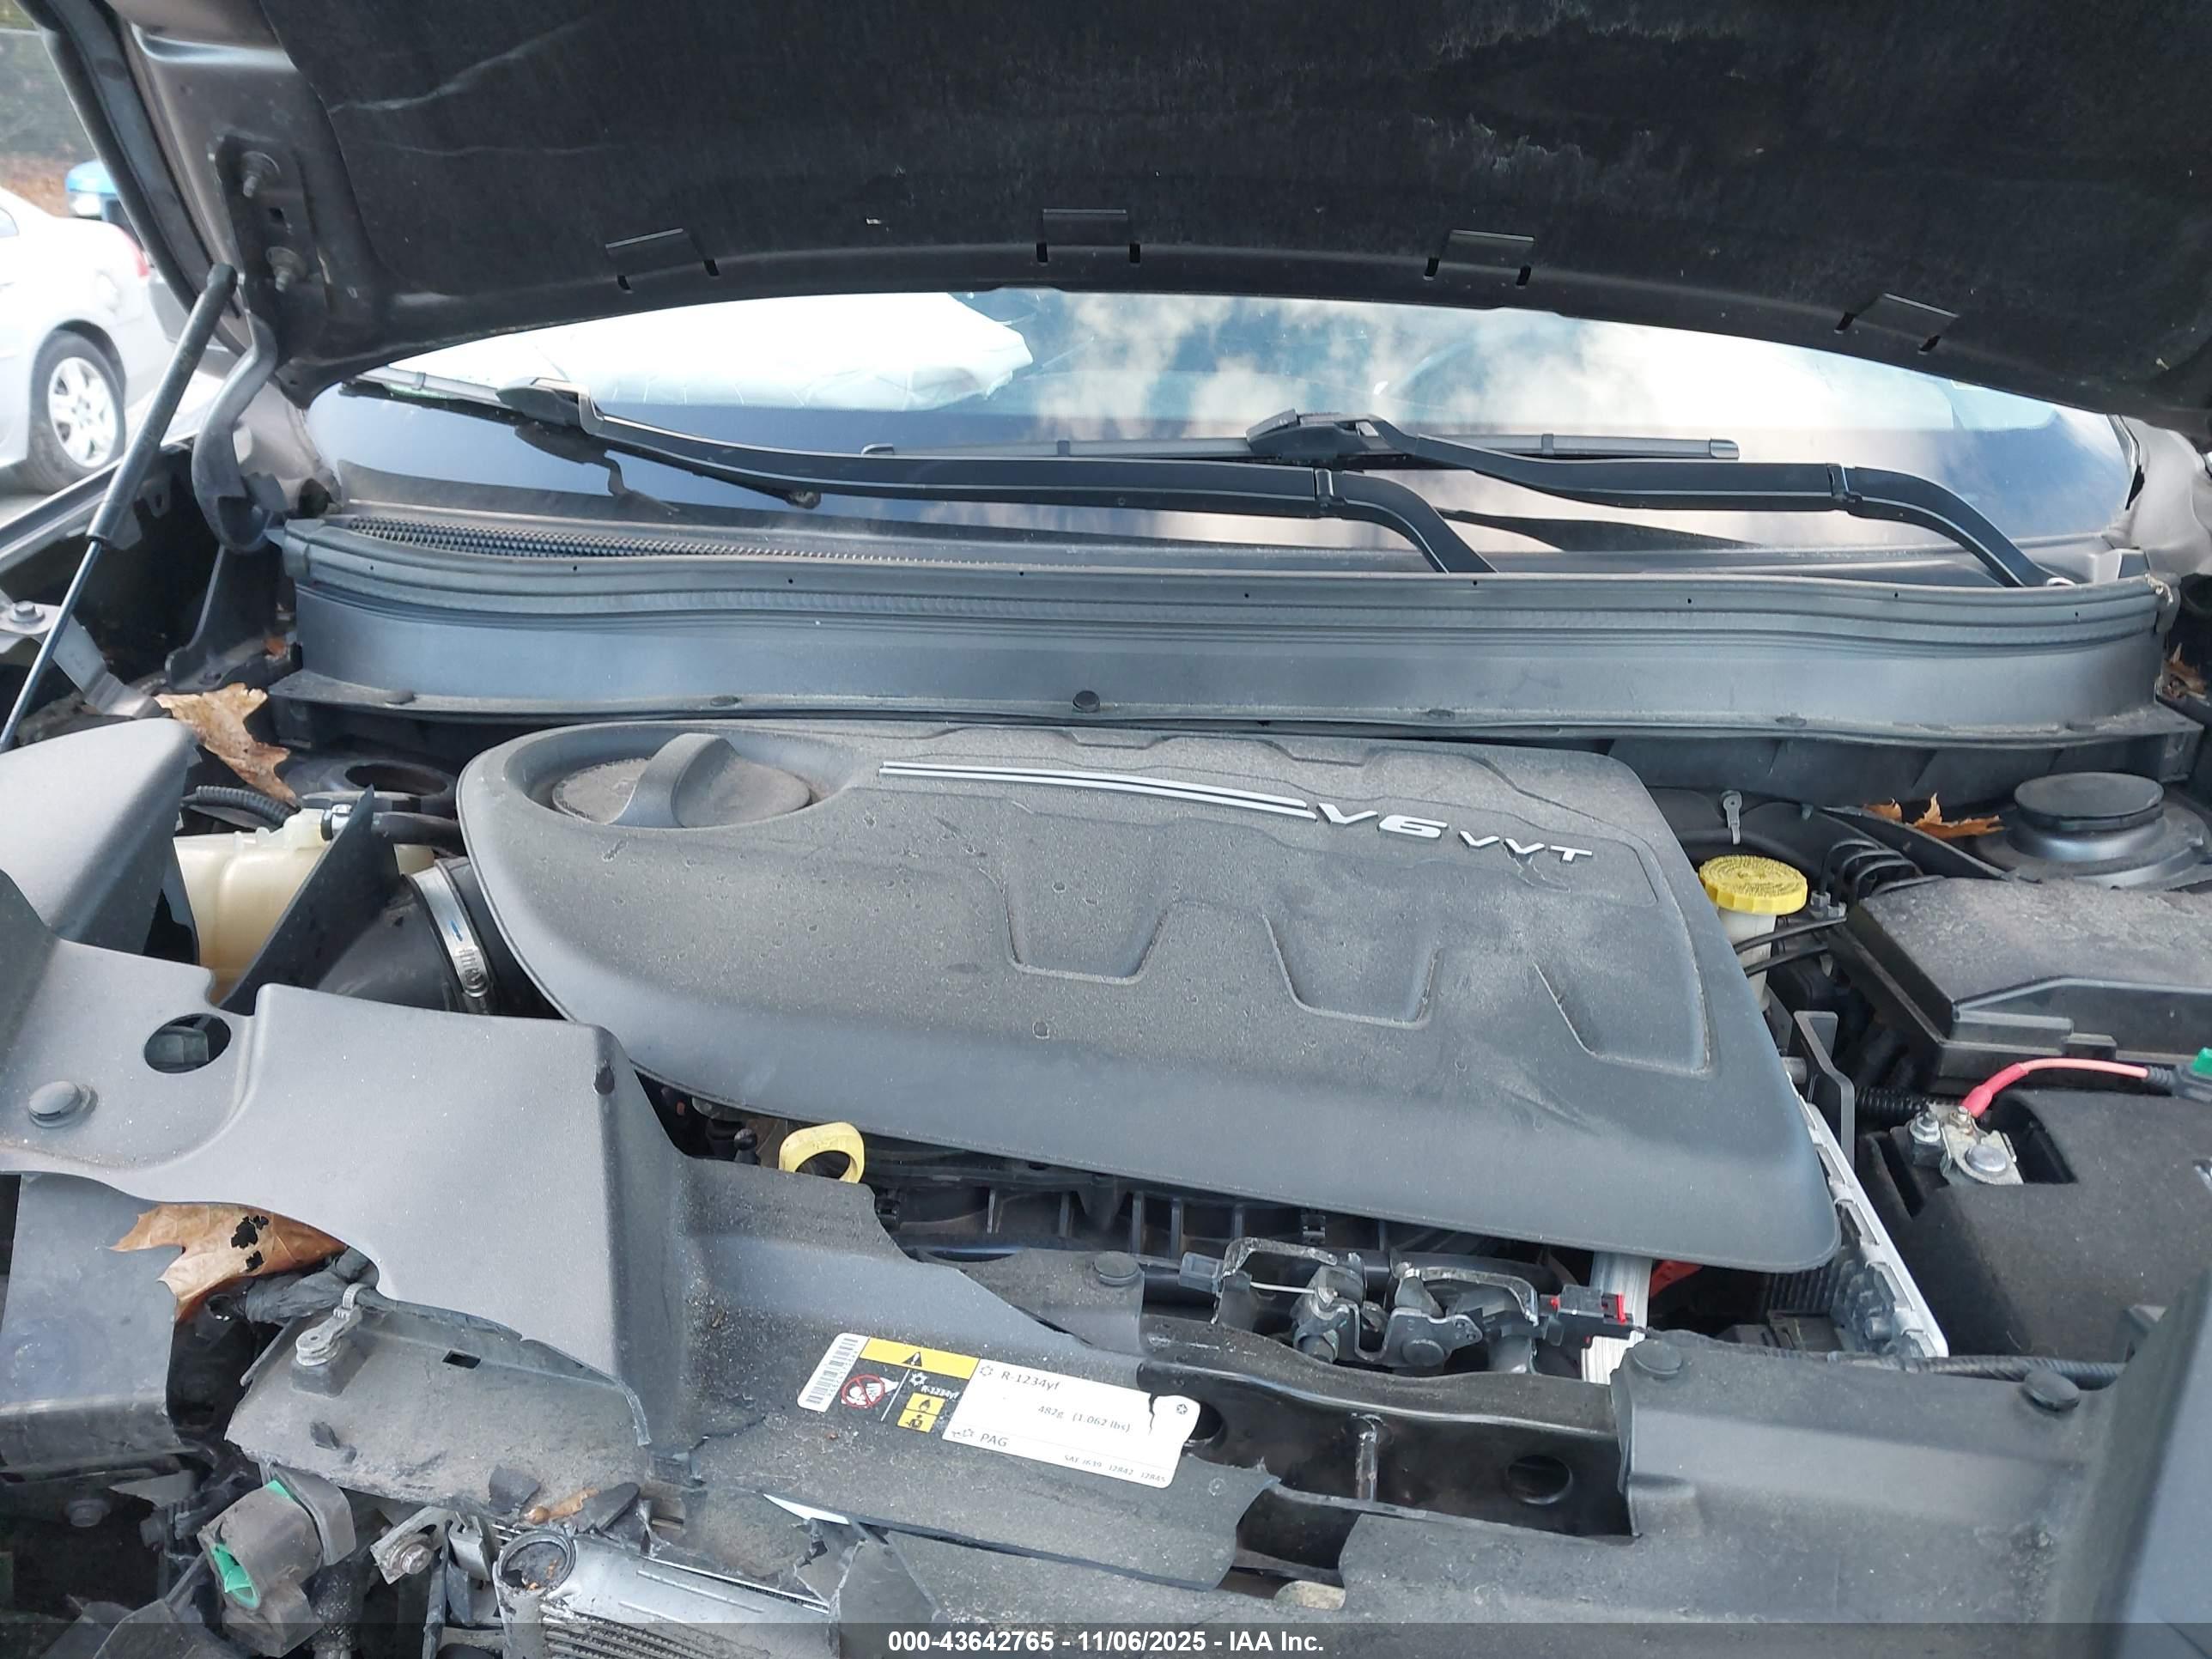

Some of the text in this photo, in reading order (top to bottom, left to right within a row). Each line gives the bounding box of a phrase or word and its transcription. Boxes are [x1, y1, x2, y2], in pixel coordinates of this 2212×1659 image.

[1316, 802, 1593, 863] V6 VVT
[1001, 1370, 1061, 1391] R-1234yf
[1072, 1413, 1108, 1427] (1.062
[980, 1433, 1009, 1447] PAG
